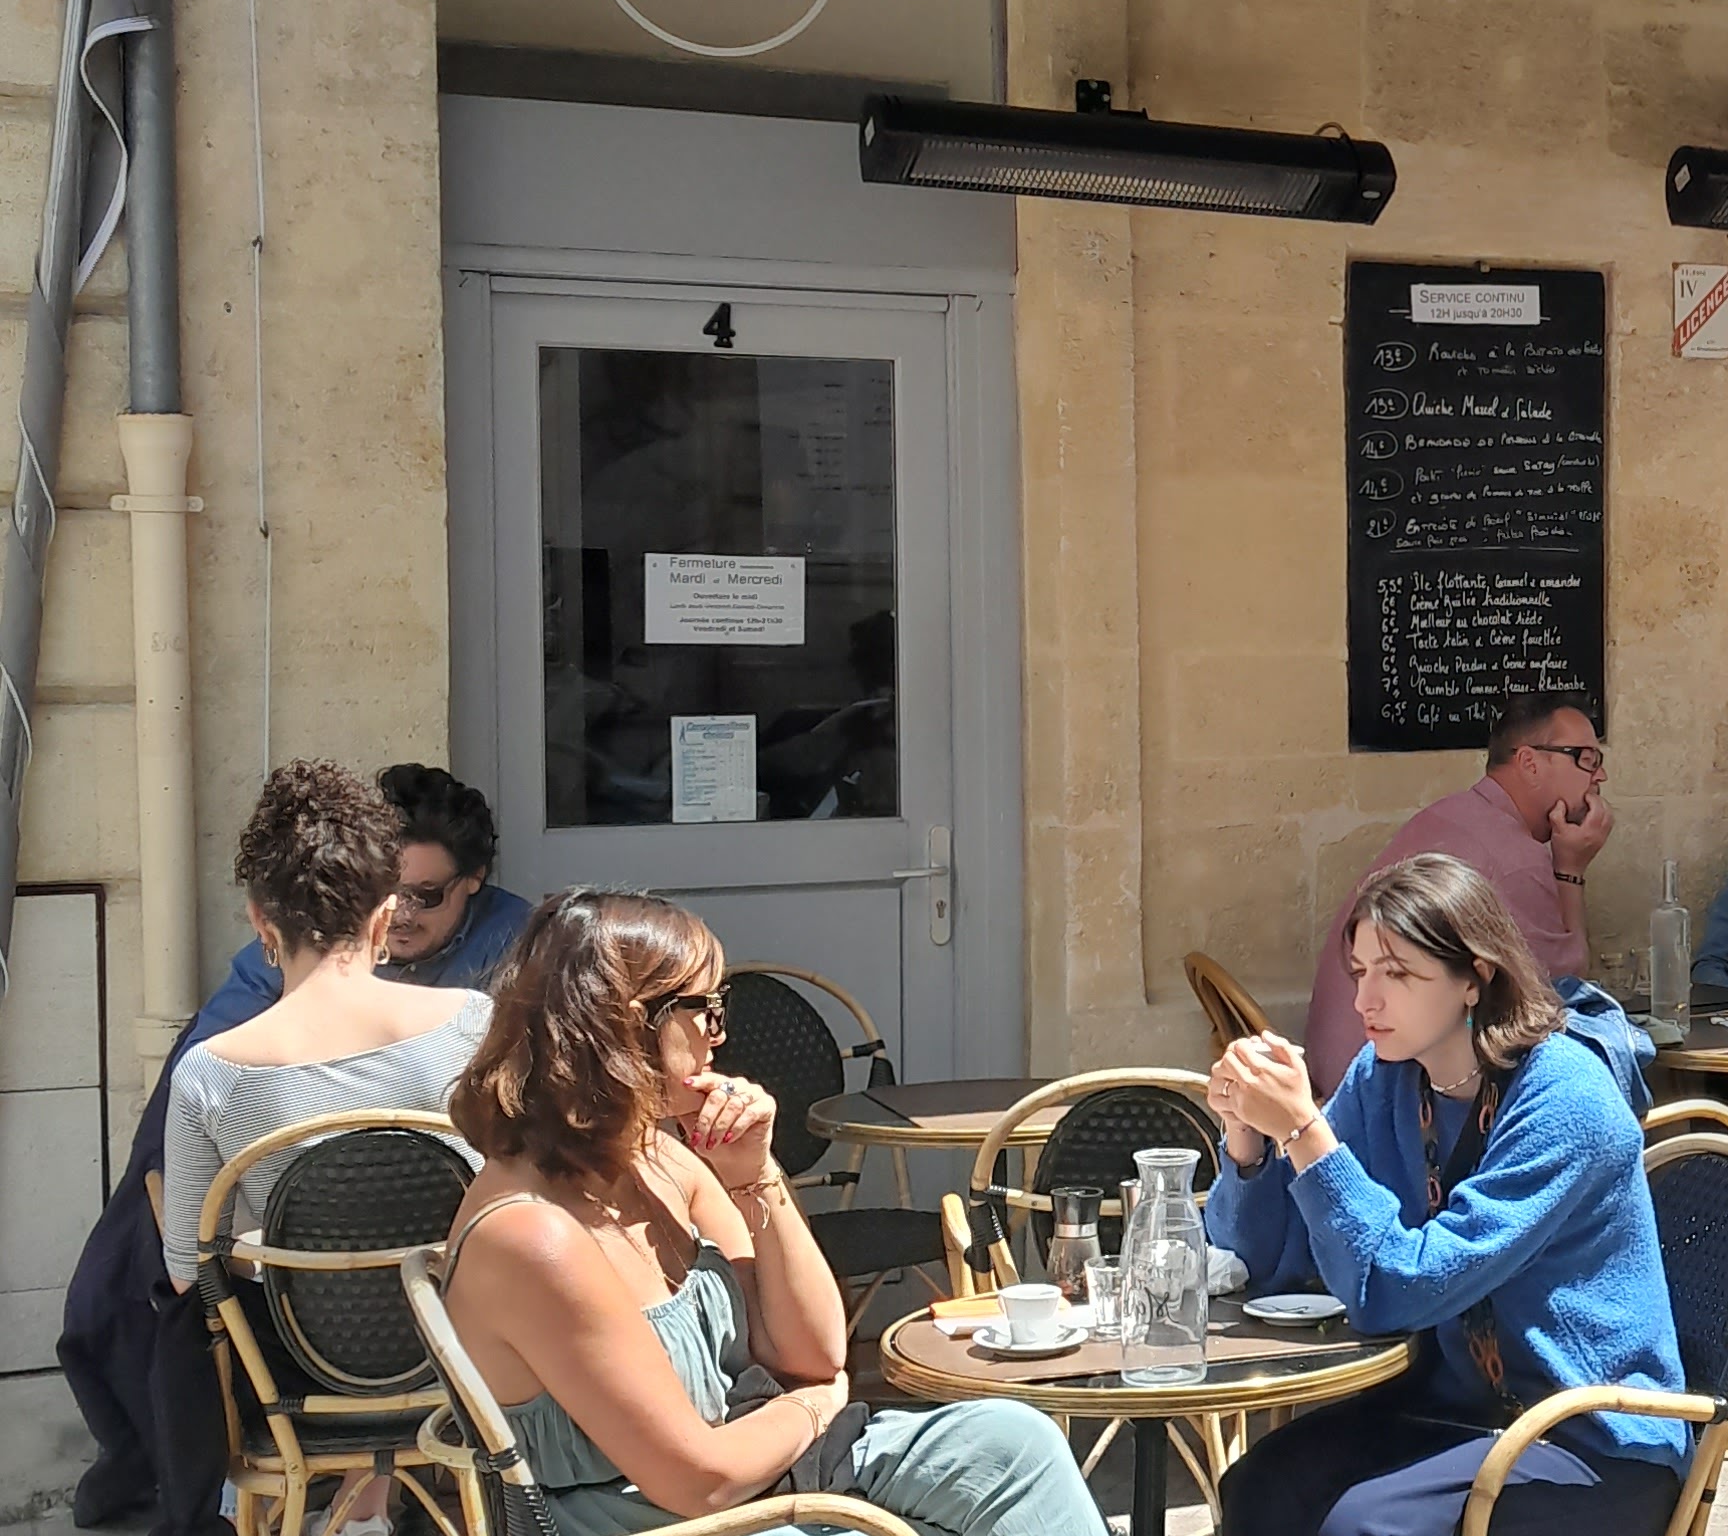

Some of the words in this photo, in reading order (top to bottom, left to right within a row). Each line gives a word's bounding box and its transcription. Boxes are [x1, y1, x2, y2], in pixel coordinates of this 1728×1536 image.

[1680, 279, 1698, 298] IV
[1430, 308, 1451, 319] 12H
[1490, 308, 1523, 319] 20H30
[703, 303, 736, 348] 4
[1412, 391, 1455, 417] Quiche
[669, 556, 737, 569] Fermeture
[669, 572, 706, 585] Mardi
[727, 573, 783, 586] Mercredi
